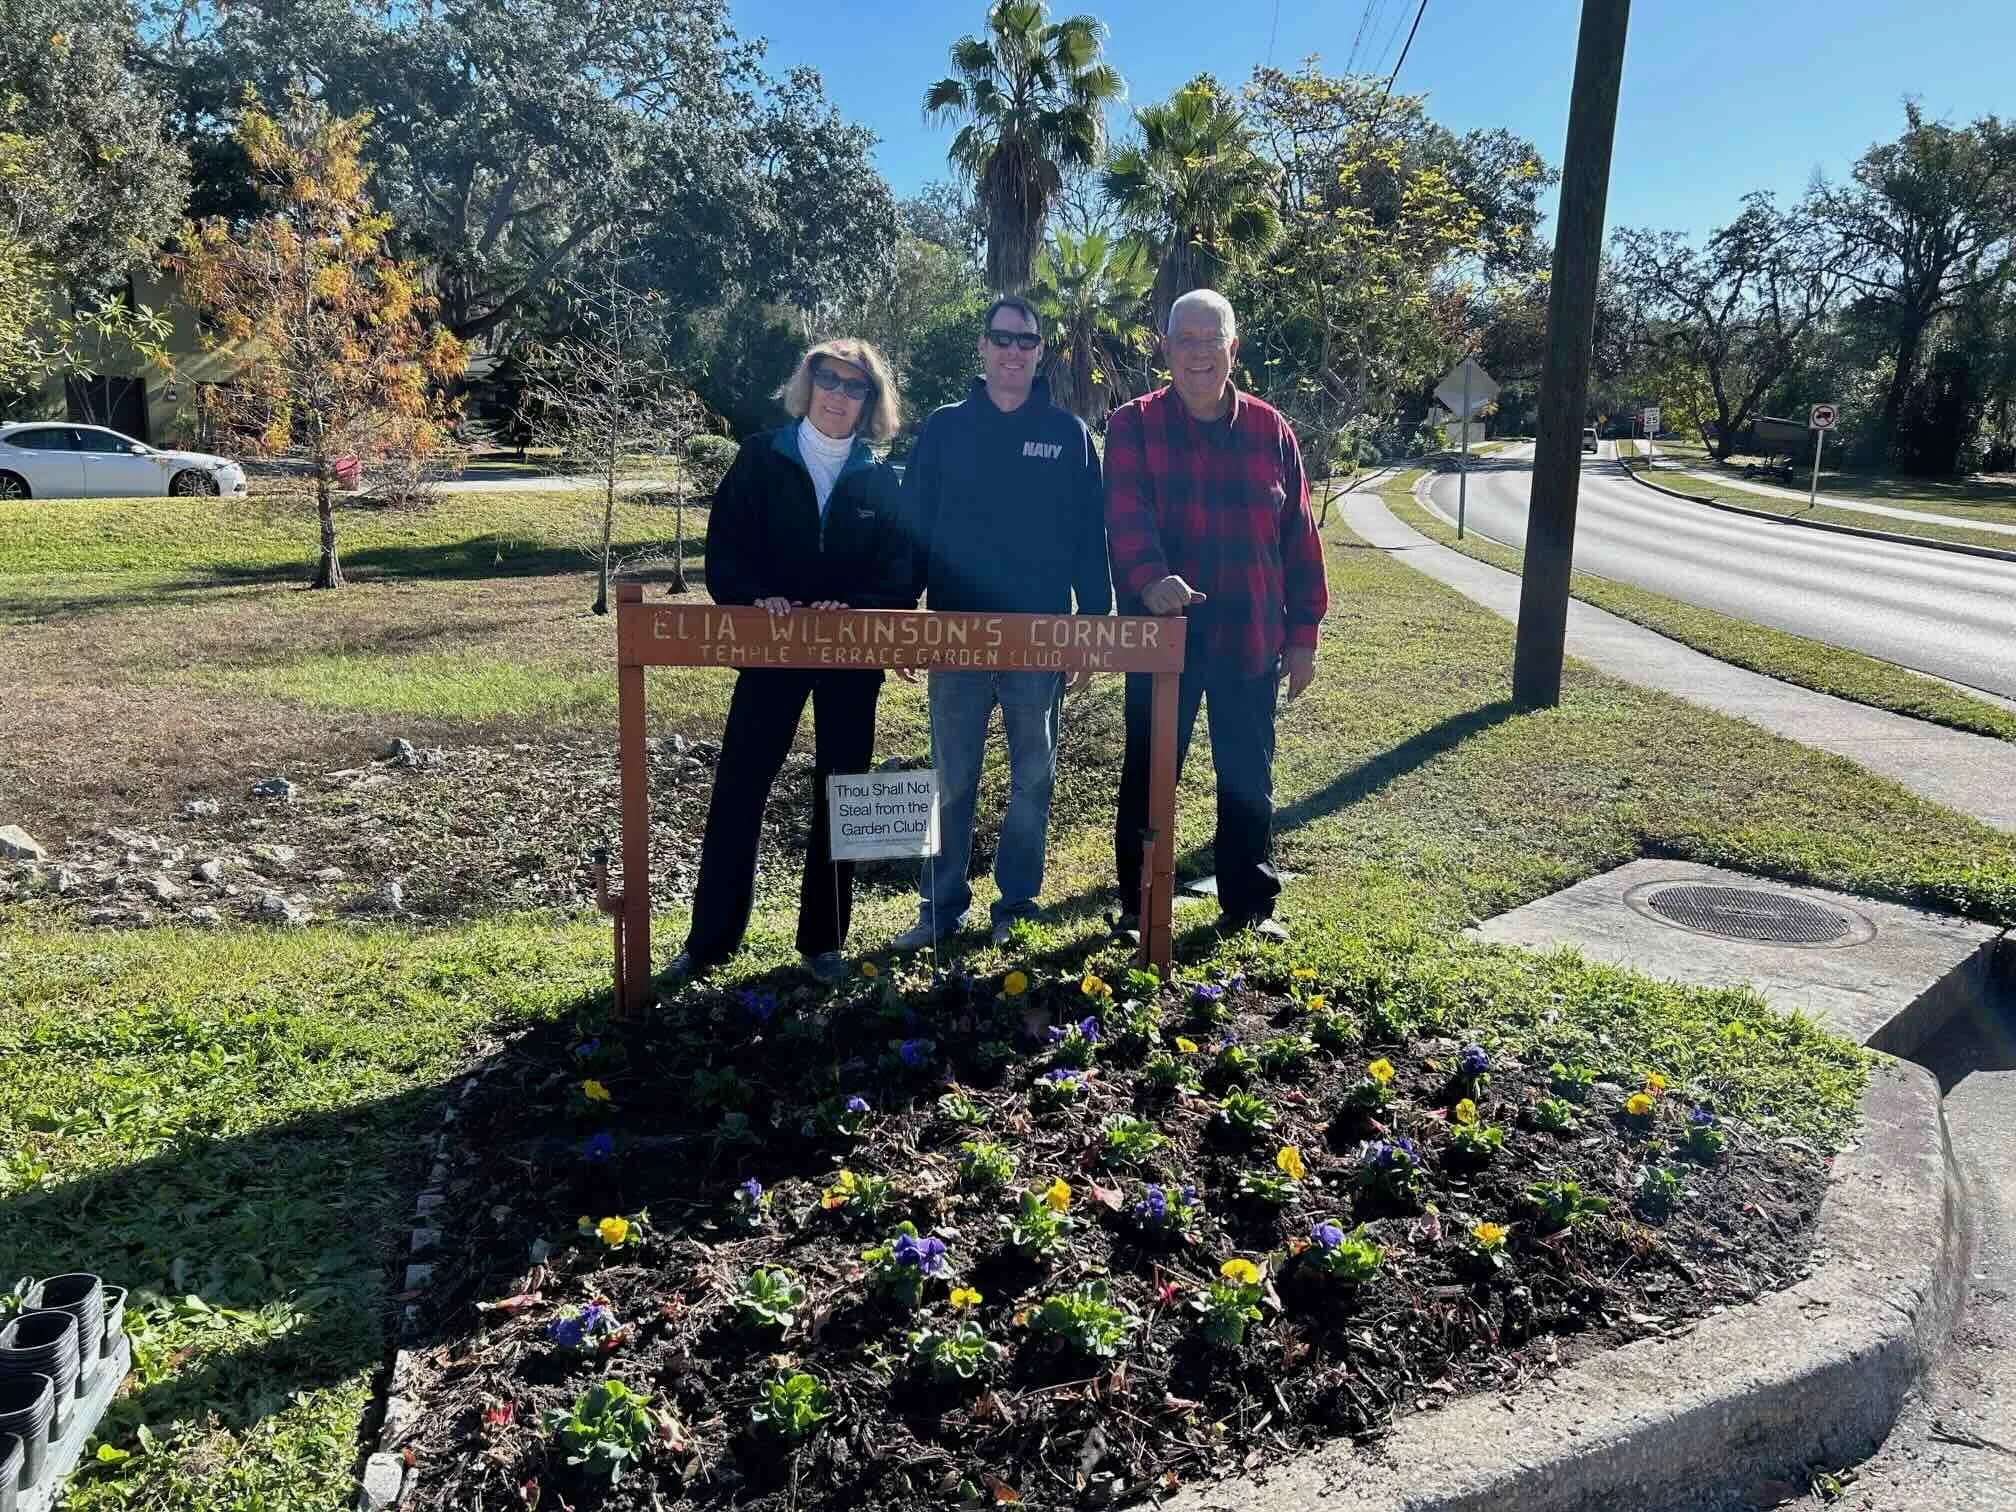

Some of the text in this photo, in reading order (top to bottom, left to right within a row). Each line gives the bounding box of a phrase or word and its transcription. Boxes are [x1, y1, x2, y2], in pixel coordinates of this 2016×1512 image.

[1023, 441, 1063, 459] NAVY
[653, 611, 1160, 649] ELIA WILKINSON'S CORNER
[699, 644, 792, 663] TEMPLE
[916, 649, 999, 666] GARDEN
[832, 781, 930, 798] Thou Shall Not
[839, 801, 928, 817] Steal from the
[841, 819, 928, 836] Garden Club!
